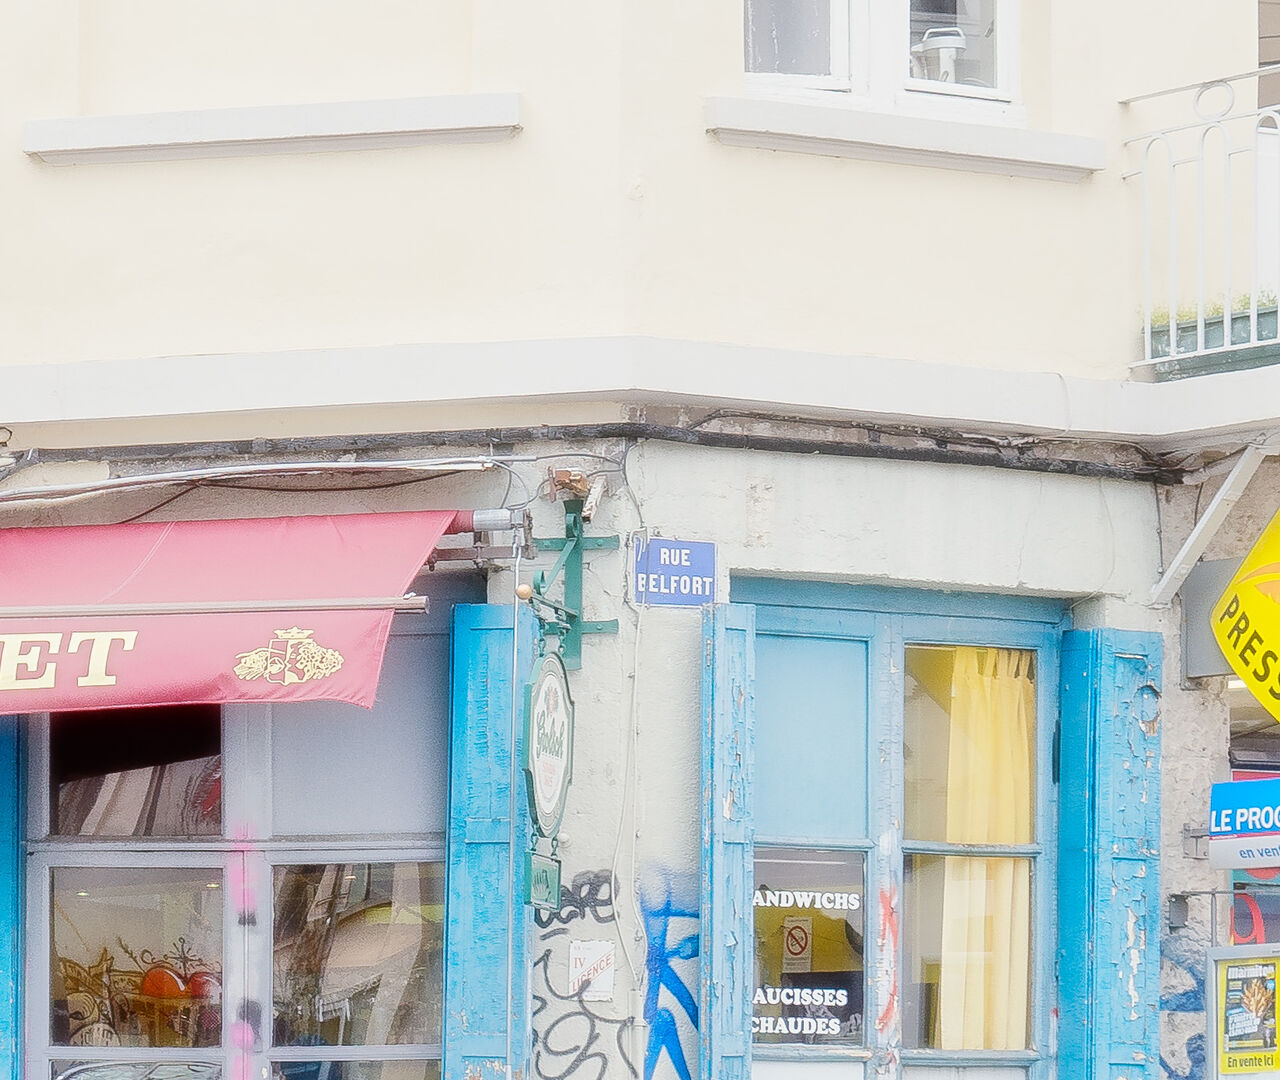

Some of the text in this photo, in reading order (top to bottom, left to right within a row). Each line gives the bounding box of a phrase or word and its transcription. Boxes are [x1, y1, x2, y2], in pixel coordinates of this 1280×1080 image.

[660, 547, 691, 567] RUE
[637, 573, 713, 596] BELFORT
[1211, 809, 1233, 832] LE
[1239, 848, 1256, 858] en
[752, 890, 860, 910] ANDWICHS
[574, 957, 586, 968] IV
[752, 986, 848, 1007] AUCISSES
[751, 1016, 840, 1035] CHAUDES
[1228, 1054, 1274, 1068] En vente Ici
